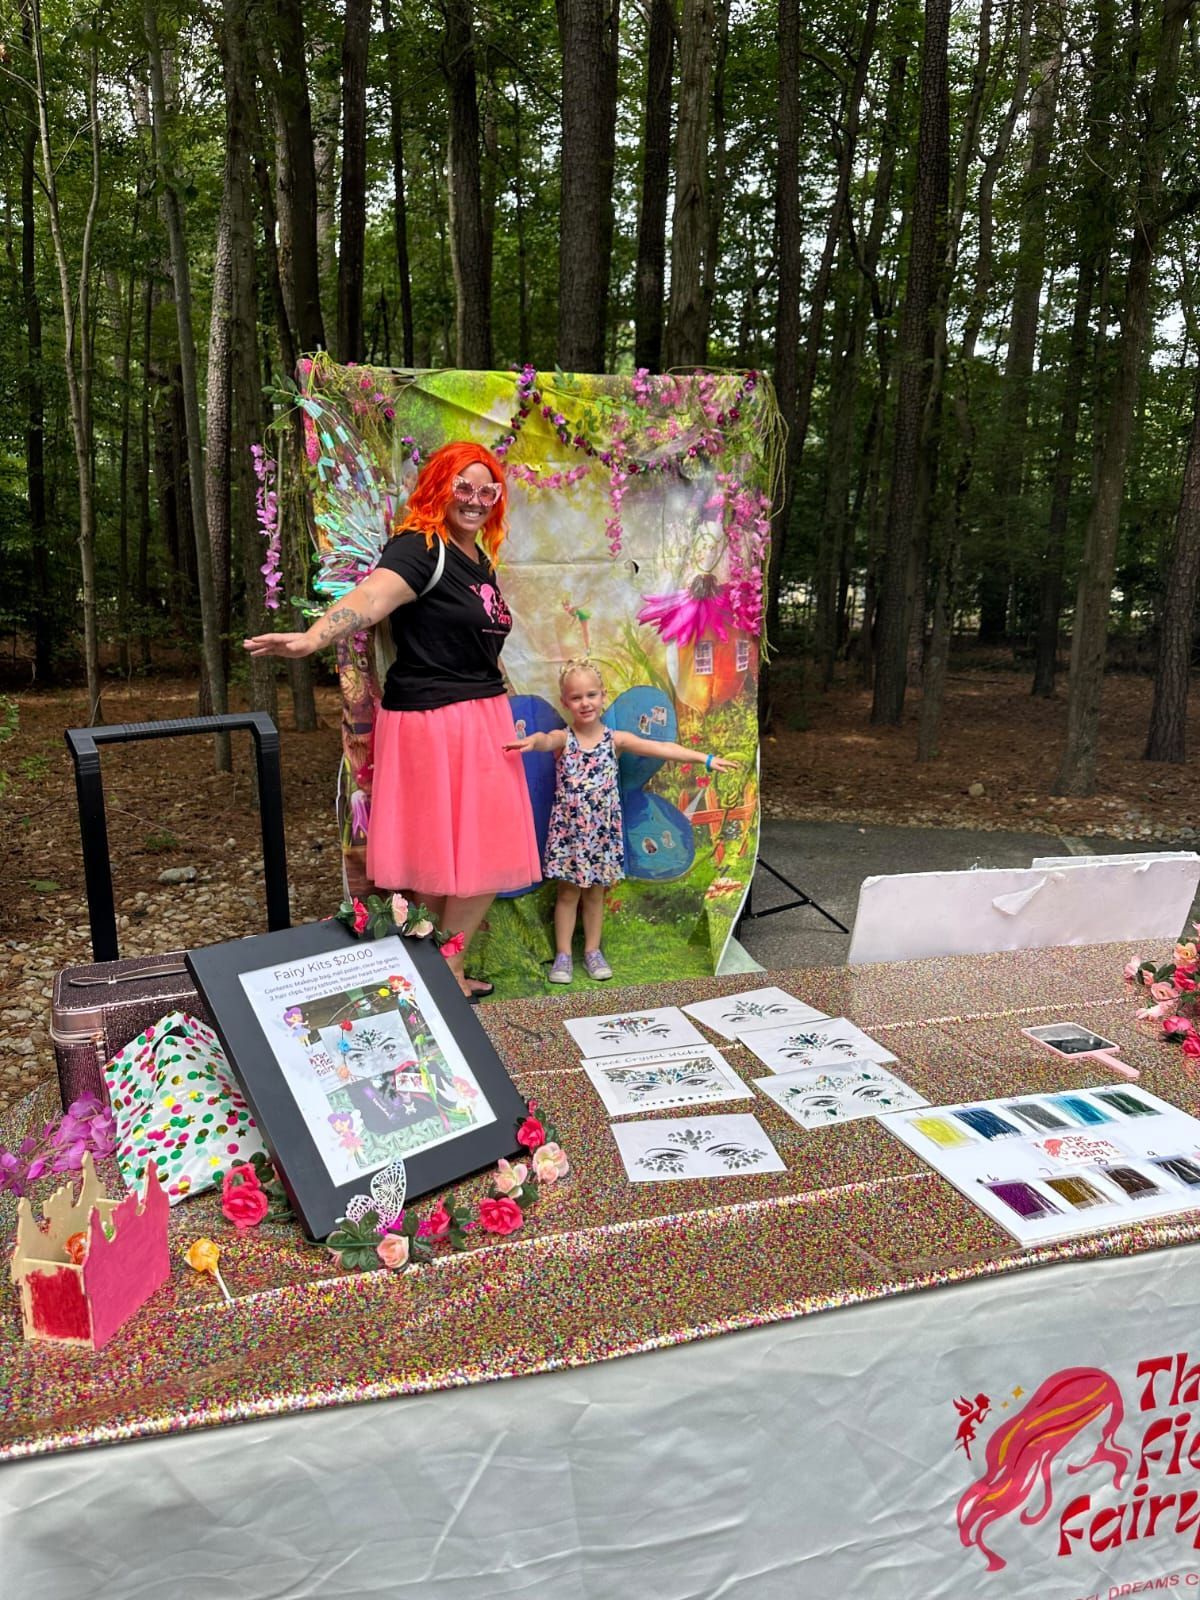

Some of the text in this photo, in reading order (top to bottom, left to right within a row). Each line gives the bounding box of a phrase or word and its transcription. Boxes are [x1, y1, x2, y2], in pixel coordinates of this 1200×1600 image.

[274, 948, 373, 981] Fairy Kits $20.00
[625, 1053, 665, 1063] Crystal
[1094, 1157, 1108, 1166] 8
[1109, 1574, 1180, 1600] DREAMS
